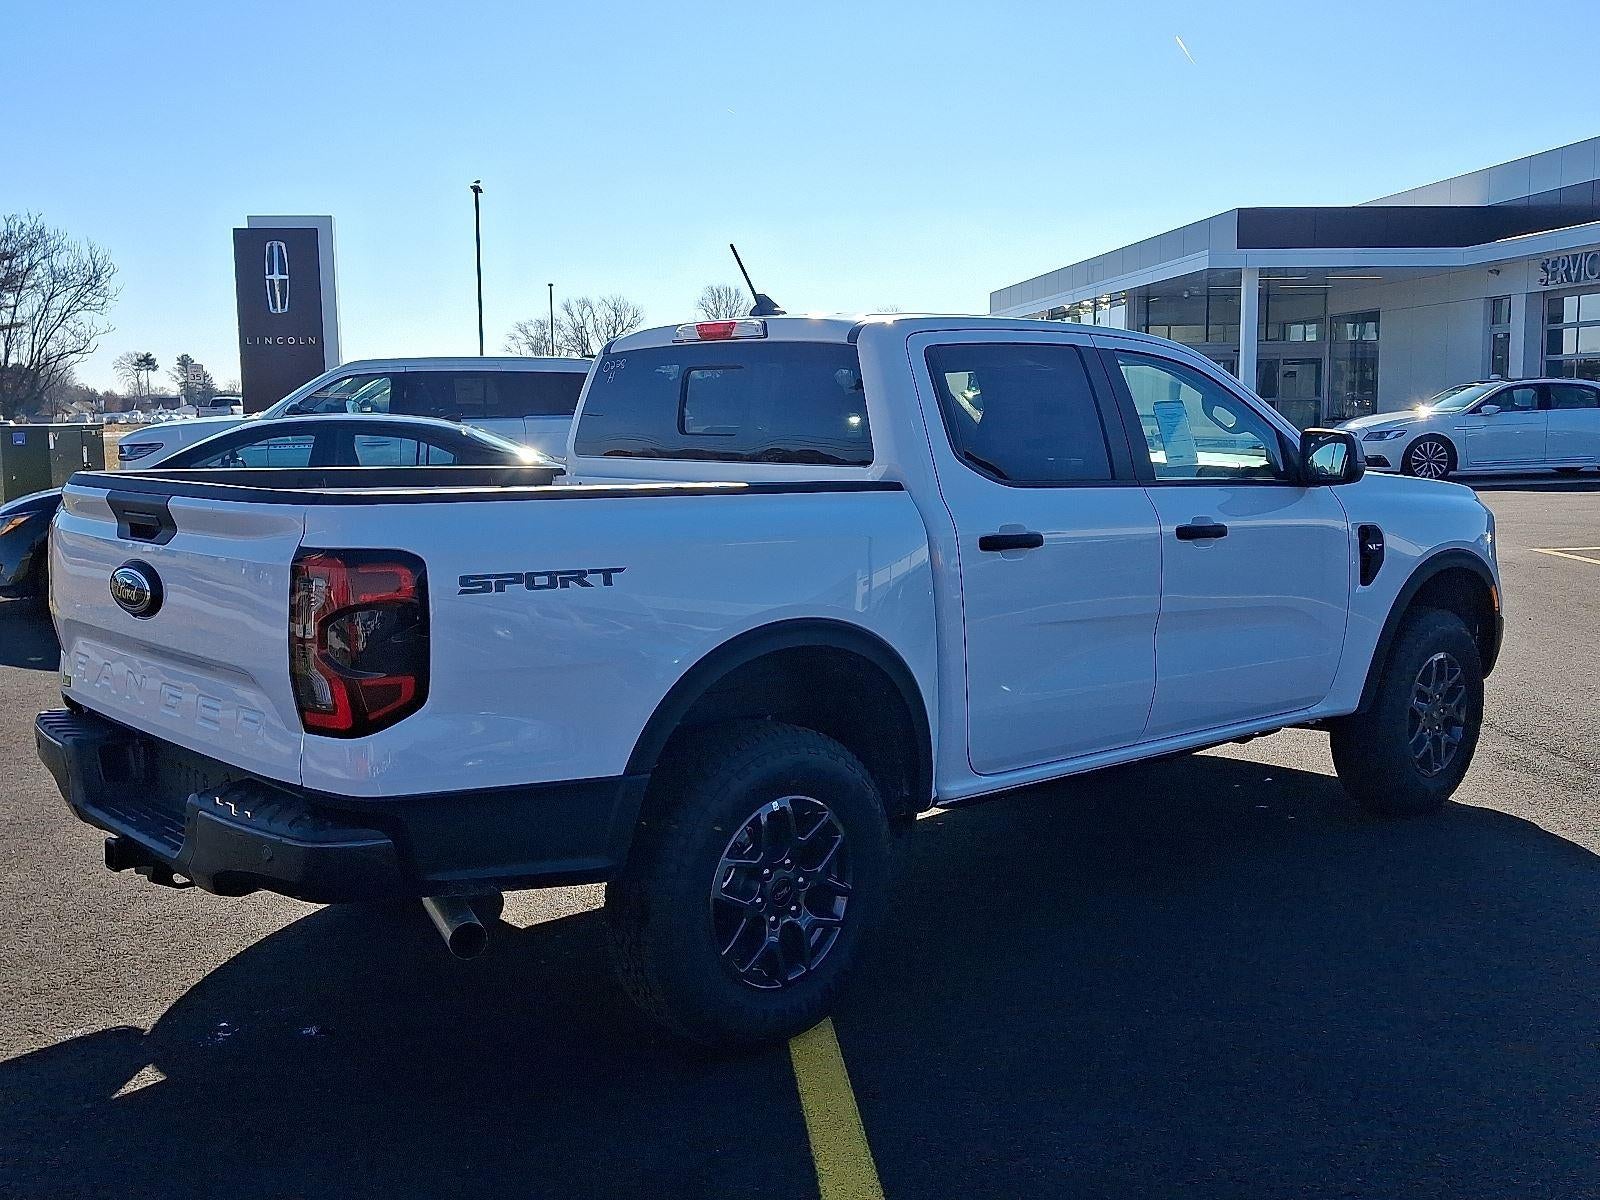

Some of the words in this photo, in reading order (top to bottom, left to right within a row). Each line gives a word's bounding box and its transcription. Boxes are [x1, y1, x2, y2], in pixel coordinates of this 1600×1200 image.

[1537, 252, 1600, 285] SERVIC
[246, 336, 317, 345] LINCOLN
[190, 373, 202, 381] 35
[115, 577, 138, 602] Ford
[457, 567, 628, 595] SPORT
[74, 651, 266, 745] RANGER
